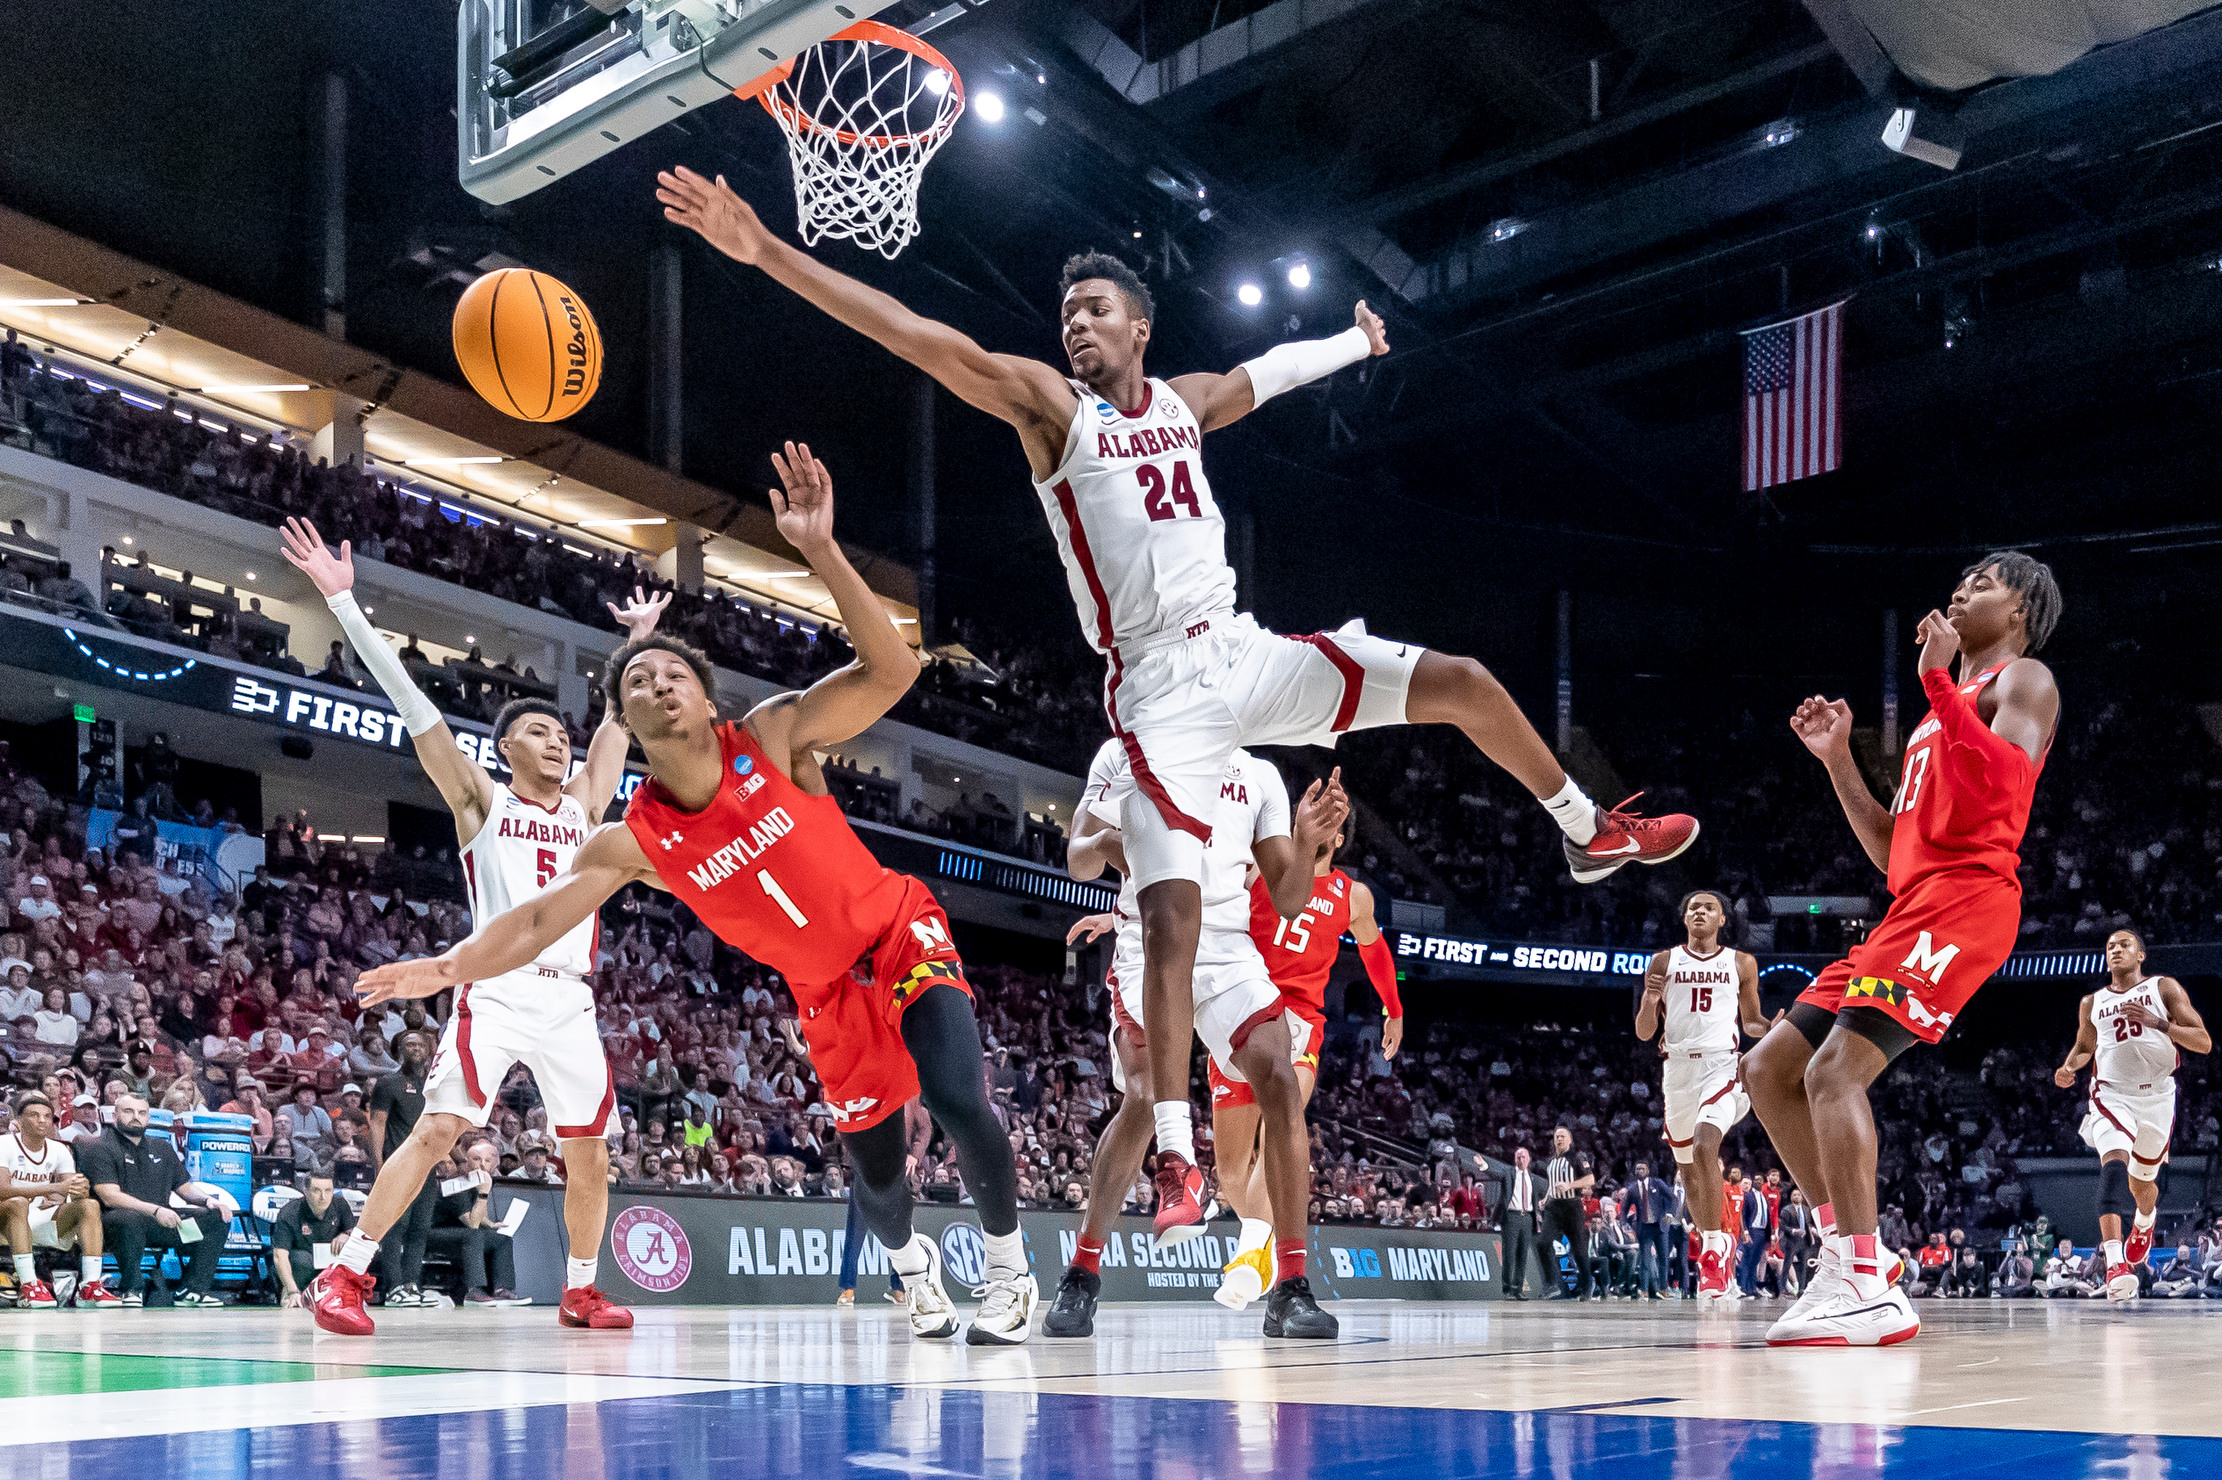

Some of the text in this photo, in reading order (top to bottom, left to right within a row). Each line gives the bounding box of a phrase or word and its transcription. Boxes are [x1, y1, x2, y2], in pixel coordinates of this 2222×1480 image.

[560, 297, 587, 396] Wilson
[1098, 426, 1199, 458] ALABAMA
[1135, 460, 1202, 522] 24
[286, 690, 407, 748] FIRST
[1897, 746, 1931, 816] 13
[498, 817, 585, 847] ALABAM
[686, 806, 795, 892] MARYLAND
[536, 848, 557, 889] 5
[756, 868, 809, 929] 1
[1272, 912, 1316, 954] 15
[1423, 937, 1488, 965] FIRST
[1512, 947, 1608, 972] SECOND
[1900, 931, 1961, 985] M
[1674, 971, 1731, 984] ALABAMA
[1690, 987, 1713, 1013] 15
[2112, 1018, 2143, 1043] 25
[615, 1211, 683, 1244] ALABAMA
[637, 1231, 669, 1264] A
[1058, 1230, 1128, 1267] NAA
[1131, 1232, 1222, 1269] SECOND
[1387, 1247, 1490, 1281] MARYLAND
[1147, 1272, 1186, 1288] HOSTED
[1187, 1273, 1200, 1288] BY
[1201, 1273, 1219, 1288] THE
